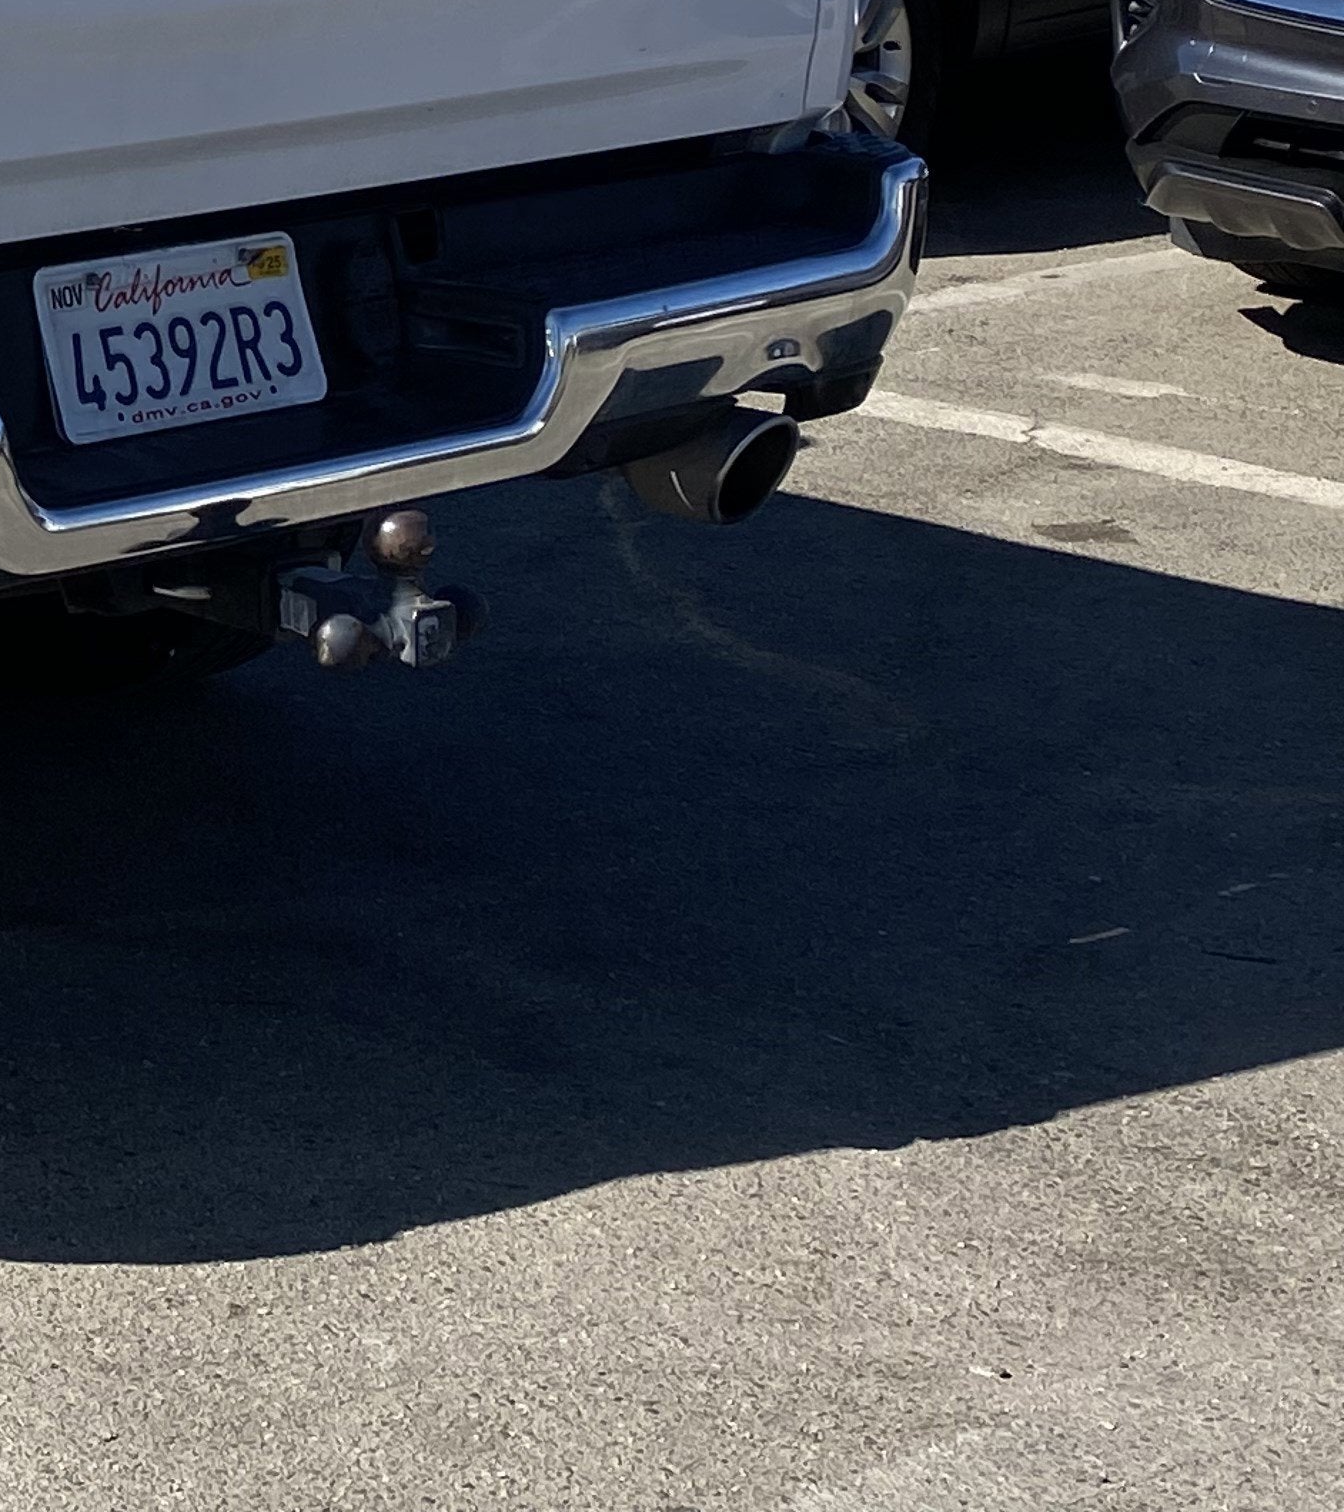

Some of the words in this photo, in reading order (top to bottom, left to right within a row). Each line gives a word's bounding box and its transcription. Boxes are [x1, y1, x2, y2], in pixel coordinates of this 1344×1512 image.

[50, 283, 84, 311] NOV
[92, 264, 252, 315] California
[72, 300, 303, 412] 45392R3
[131, 390, 263, 424] dmv.ca.gov
